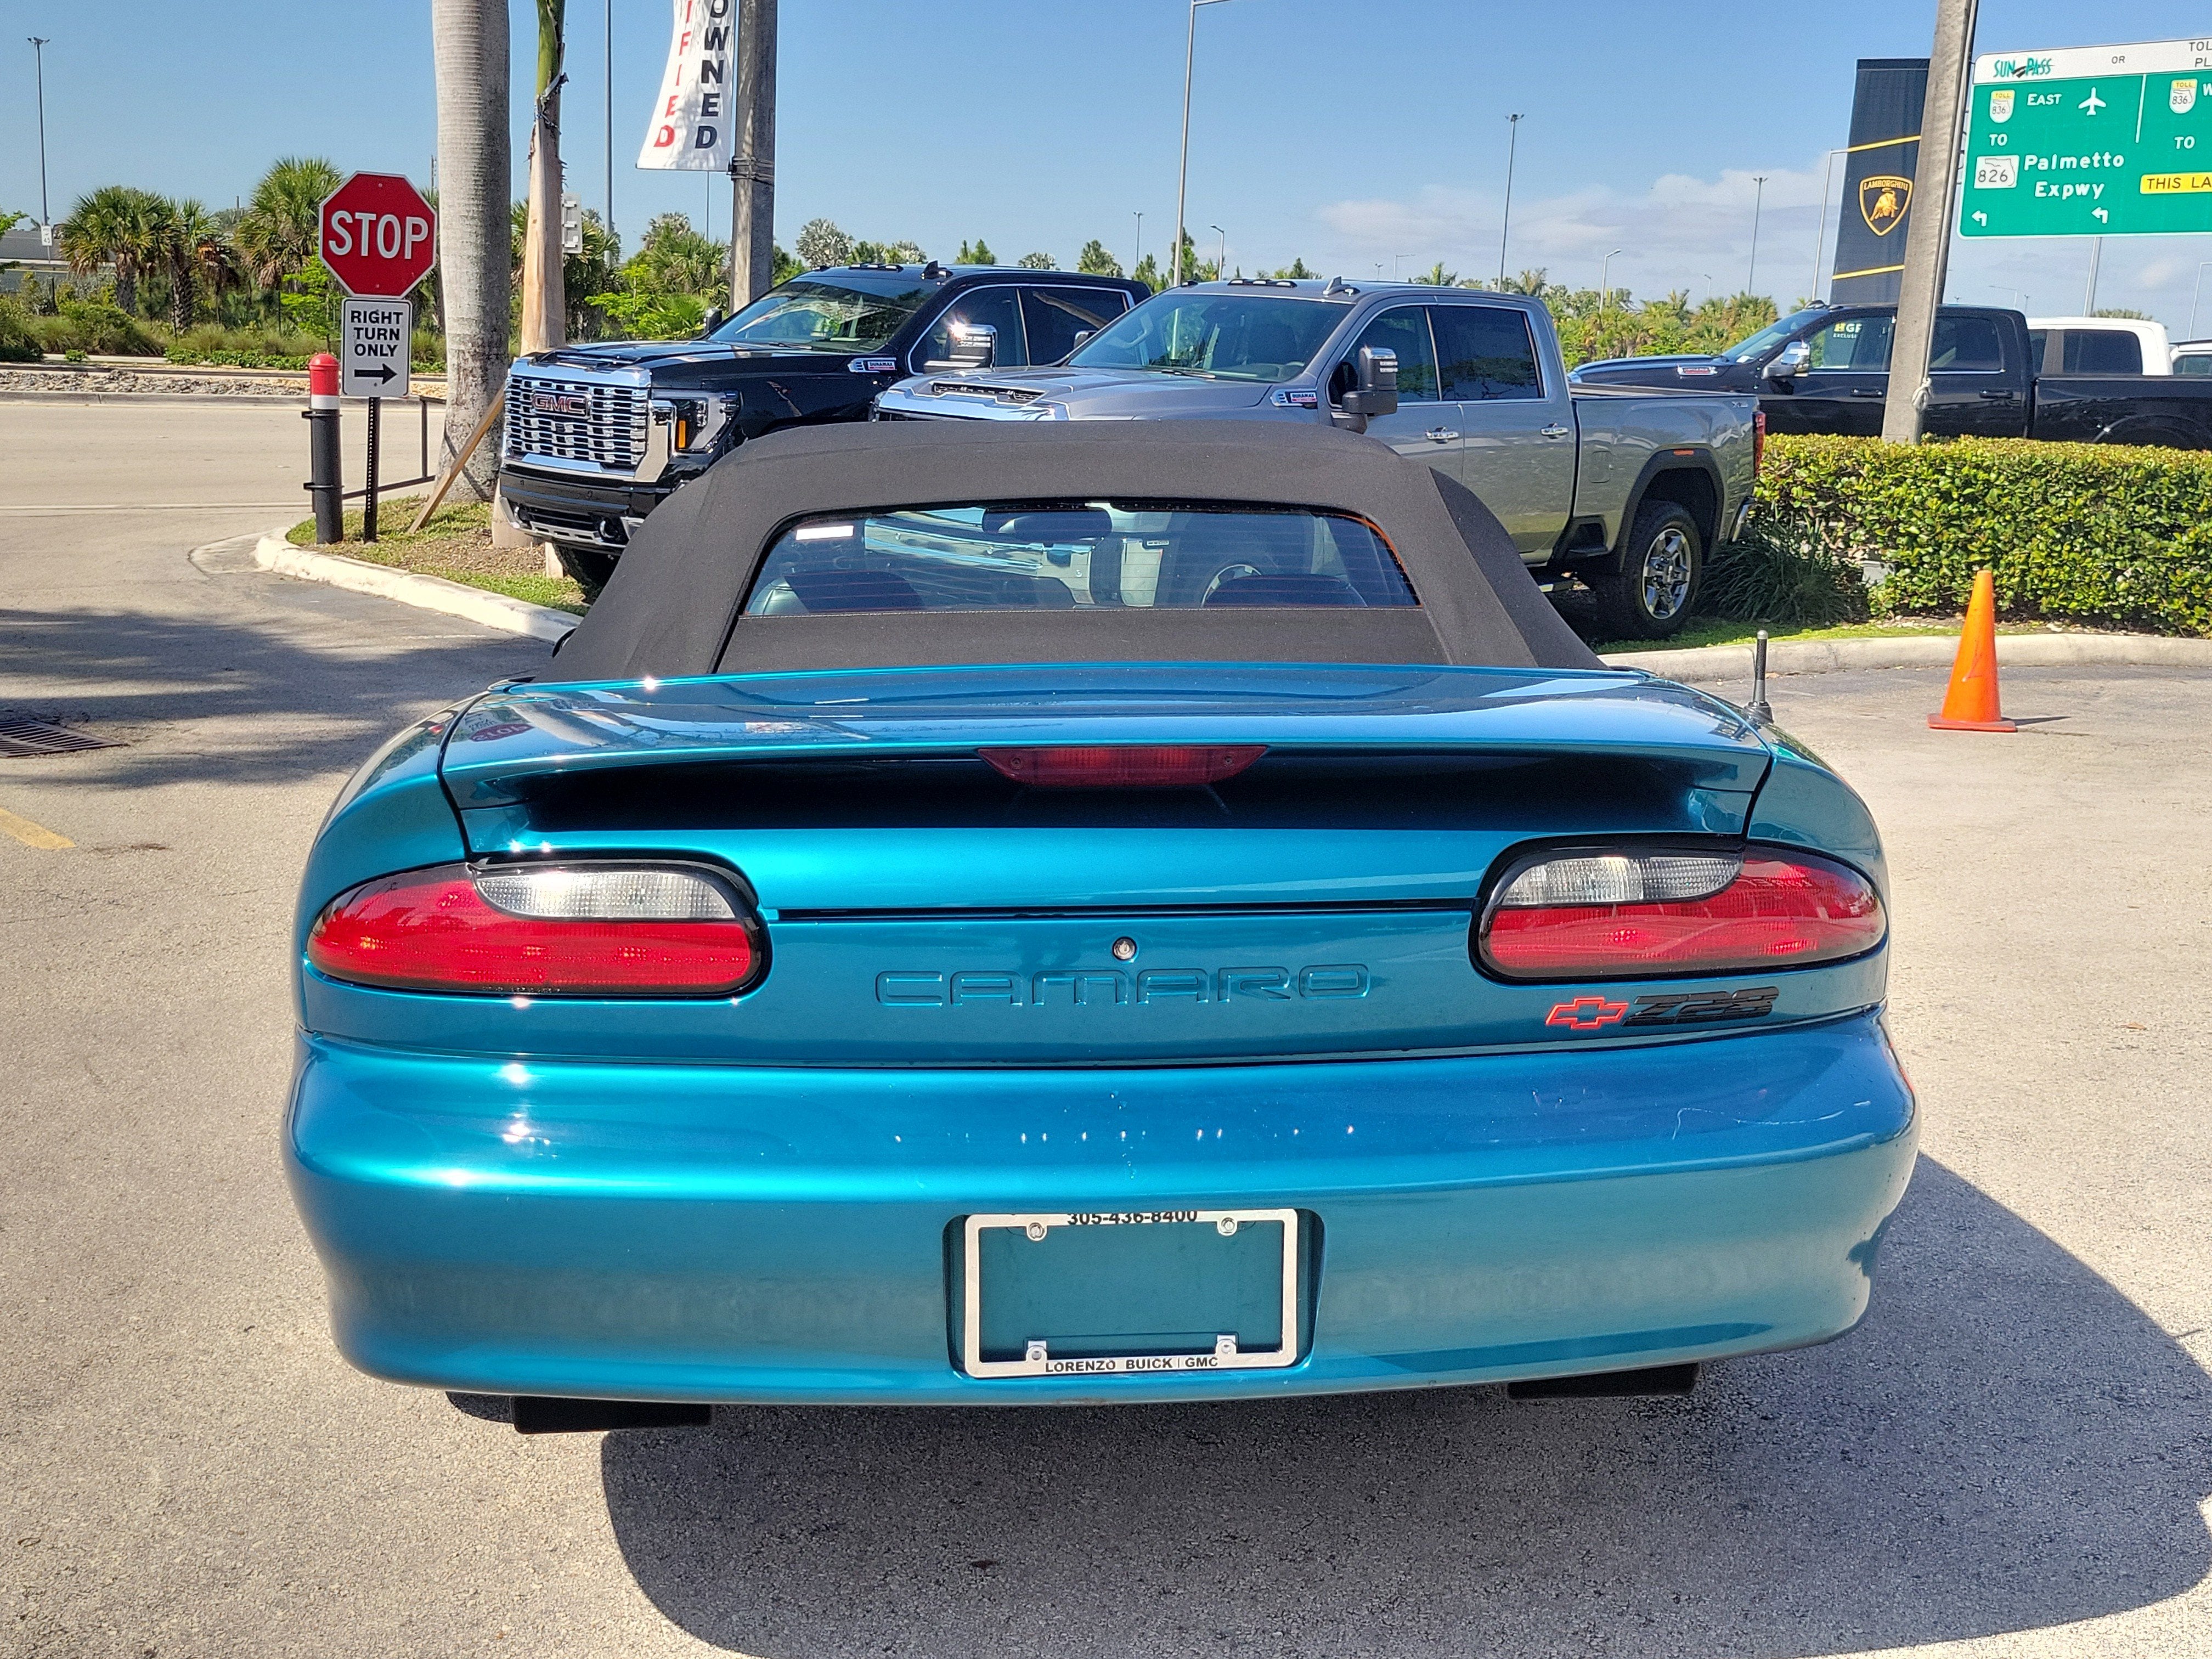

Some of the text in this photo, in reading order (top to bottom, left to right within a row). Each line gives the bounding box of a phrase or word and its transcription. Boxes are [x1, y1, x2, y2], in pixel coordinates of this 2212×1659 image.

[2111, 55, 2126, 64] OR
[2194, 57, 2212, 67] PL
[695, 0, 730, 149] OWNED
[2027, 93, 2062, 106] EAST
[2172, 95, 2188, 105] 836
[1991, 105, 2006, 115] 836
[1989, 133, 2008, 146] TO
[2174, 136, 2196, 150] TO
[2023, 151, 2125, 171] Palmetto
[1978, 168, 2008, 183] 826
[1864, 179, 1909, 191] LAMBORGHINI
[2034, 180, 2105, 200] Expwy
[2146, 176, 2212, 190] THIS LA
[329, 210, 428, 260] STOP
[350, 309, 404, 325] RIGHT
[353, 327, 400, 341] TURN
[354, 343, 398, 357] ONLY
[532, 393, 586, 415] GMC
[876, 963, 1371, 1007] CAMARO
[1621, 985, 1780, 1026] Z28
[1066, 1210, 1198, 1225] 305-436-8400
[1045, 1357, 1218, 1372] LORENZO BUICK GMC
